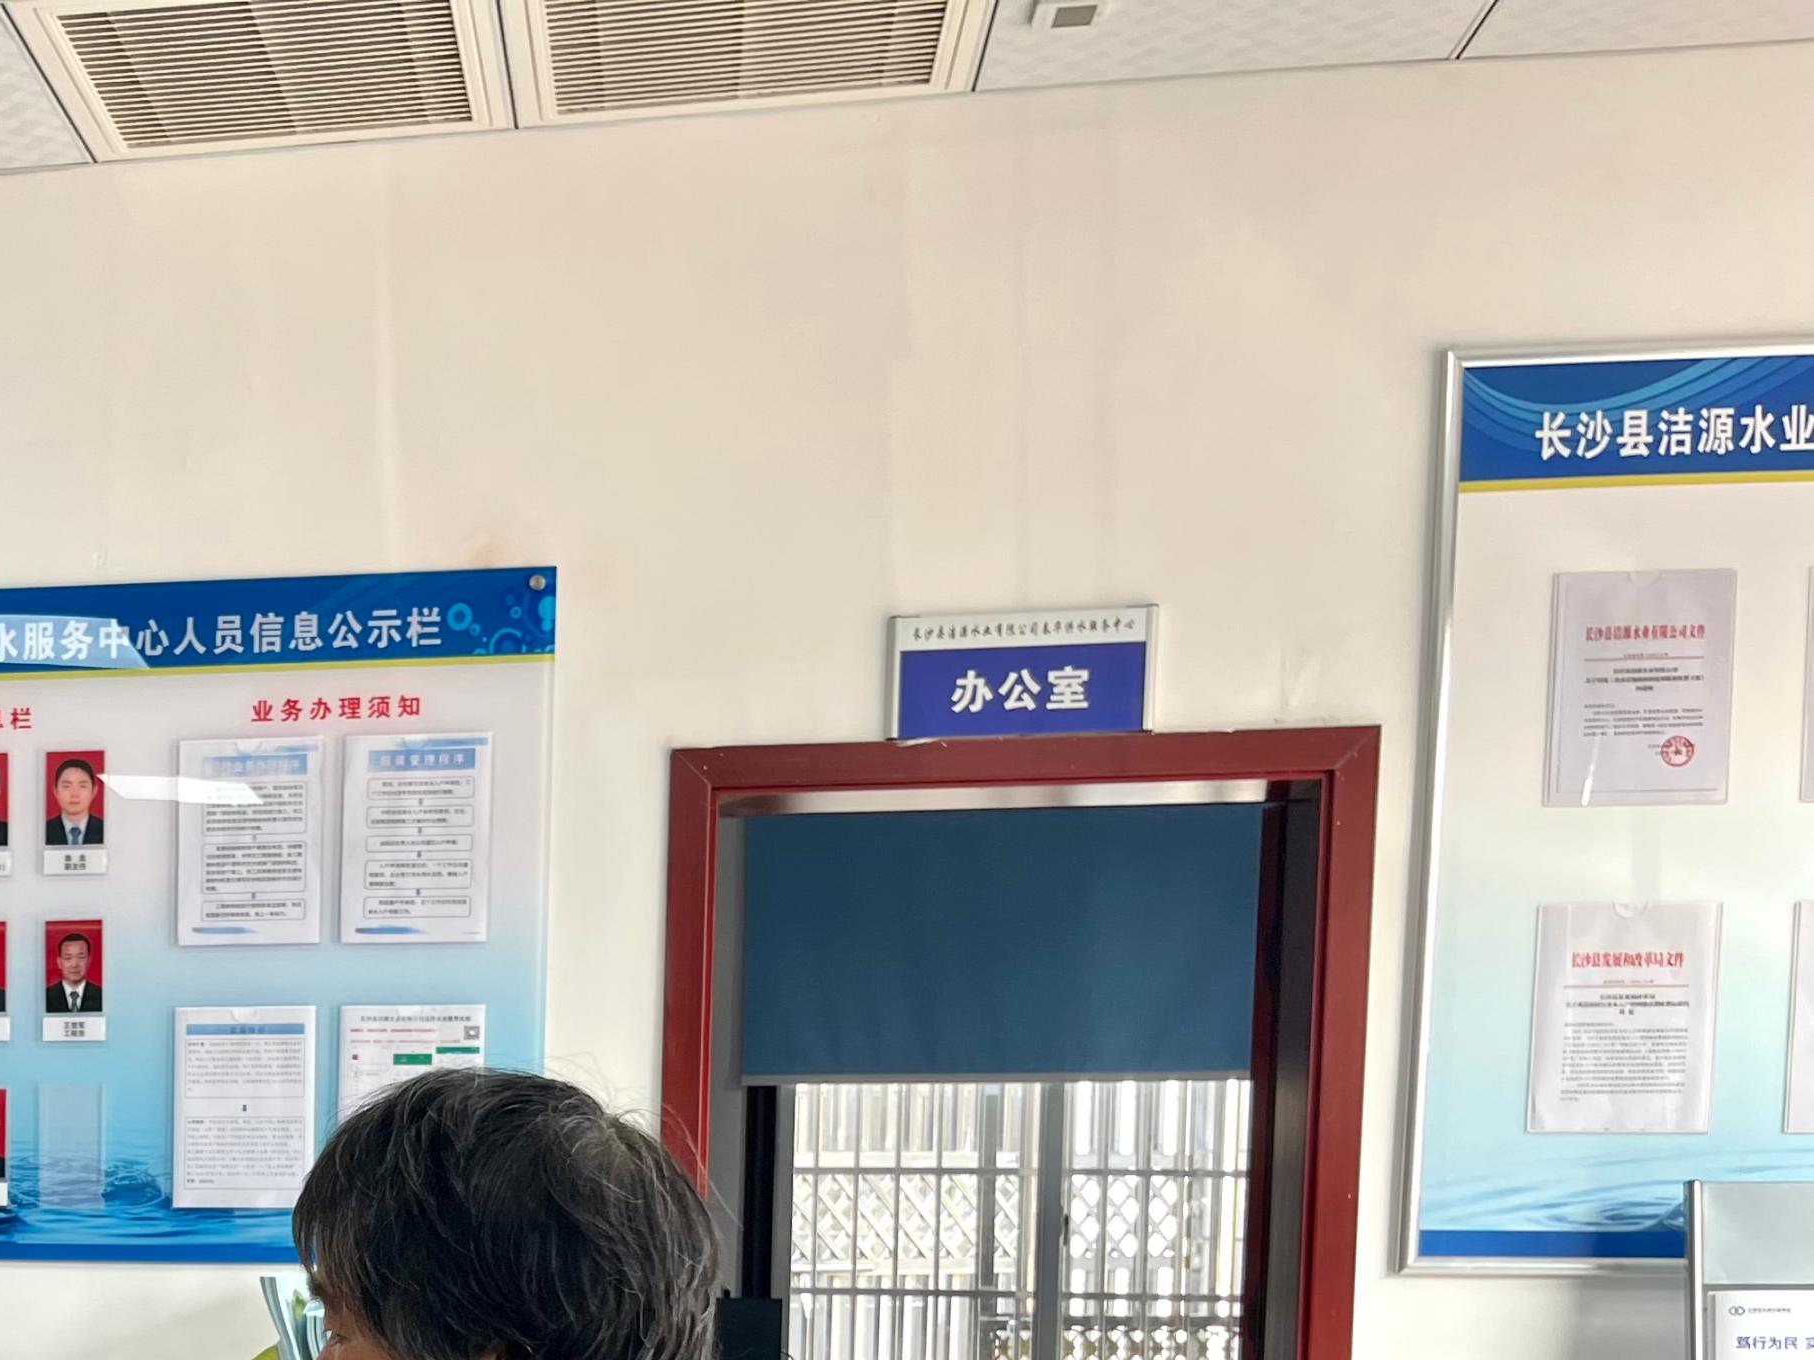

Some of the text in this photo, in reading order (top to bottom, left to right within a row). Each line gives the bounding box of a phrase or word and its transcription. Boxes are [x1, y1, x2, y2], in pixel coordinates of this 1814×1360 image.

[1535, 404, 1814, 461] 长沙县洁源水业
[951, 665, 1089, 713] 办公室
[251, 695, 422, 723] 业务办理须知
[1736, 1336, 1798, 1350] 笃行为民
